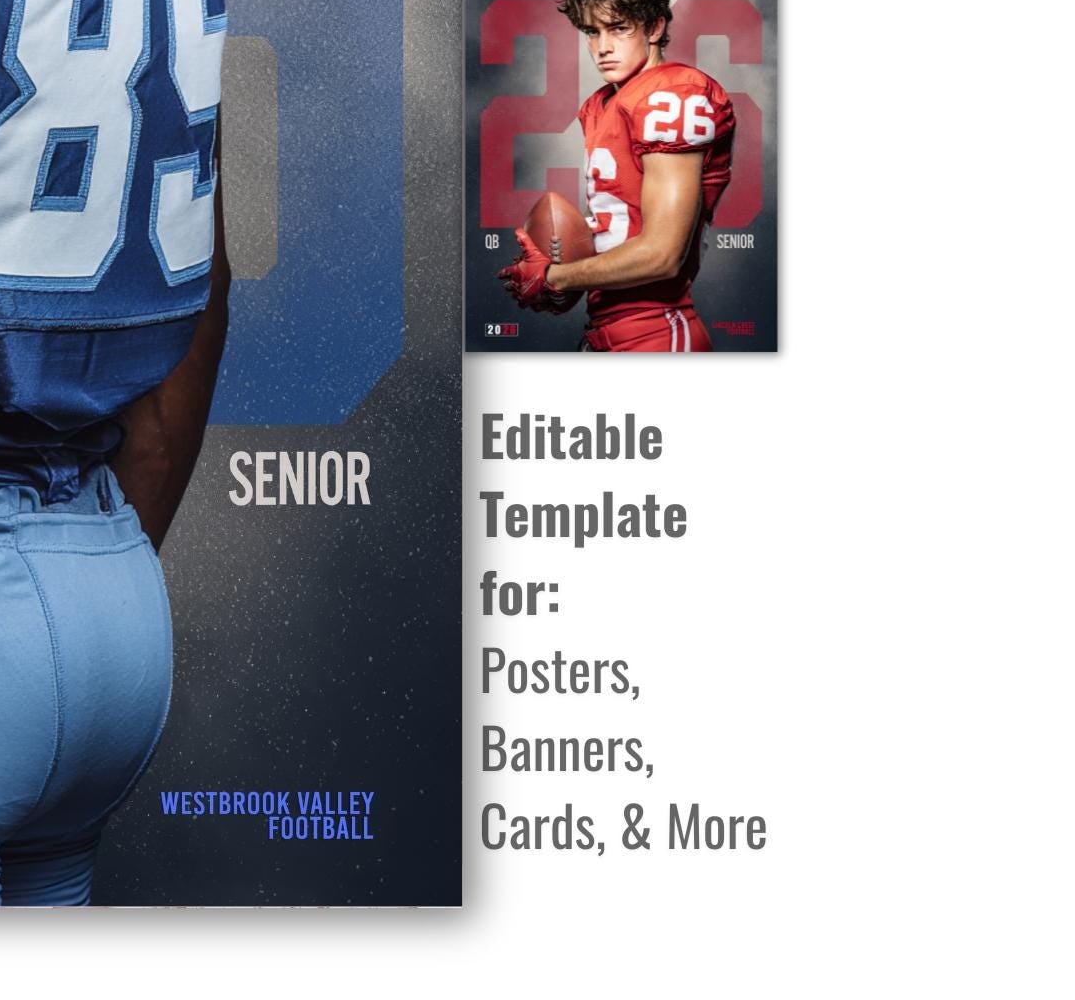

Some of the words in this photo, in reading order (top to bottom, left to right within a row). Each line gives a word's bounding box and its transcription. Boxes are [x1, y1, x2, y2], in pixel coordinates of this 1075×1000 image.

[643, 91, 715, 146] 26
[585, 147, 630, 253] 6
[485, 234, 500, 250] QB
[716, 234, 754, 249] SENIOR
[228, 451, 371, 505] SENIOR
[161, 792, 289, 814] WESTBROOK
[297, 792, 374, 814] VALLEY
[268, 817, 374, 840] FOOTBALL
